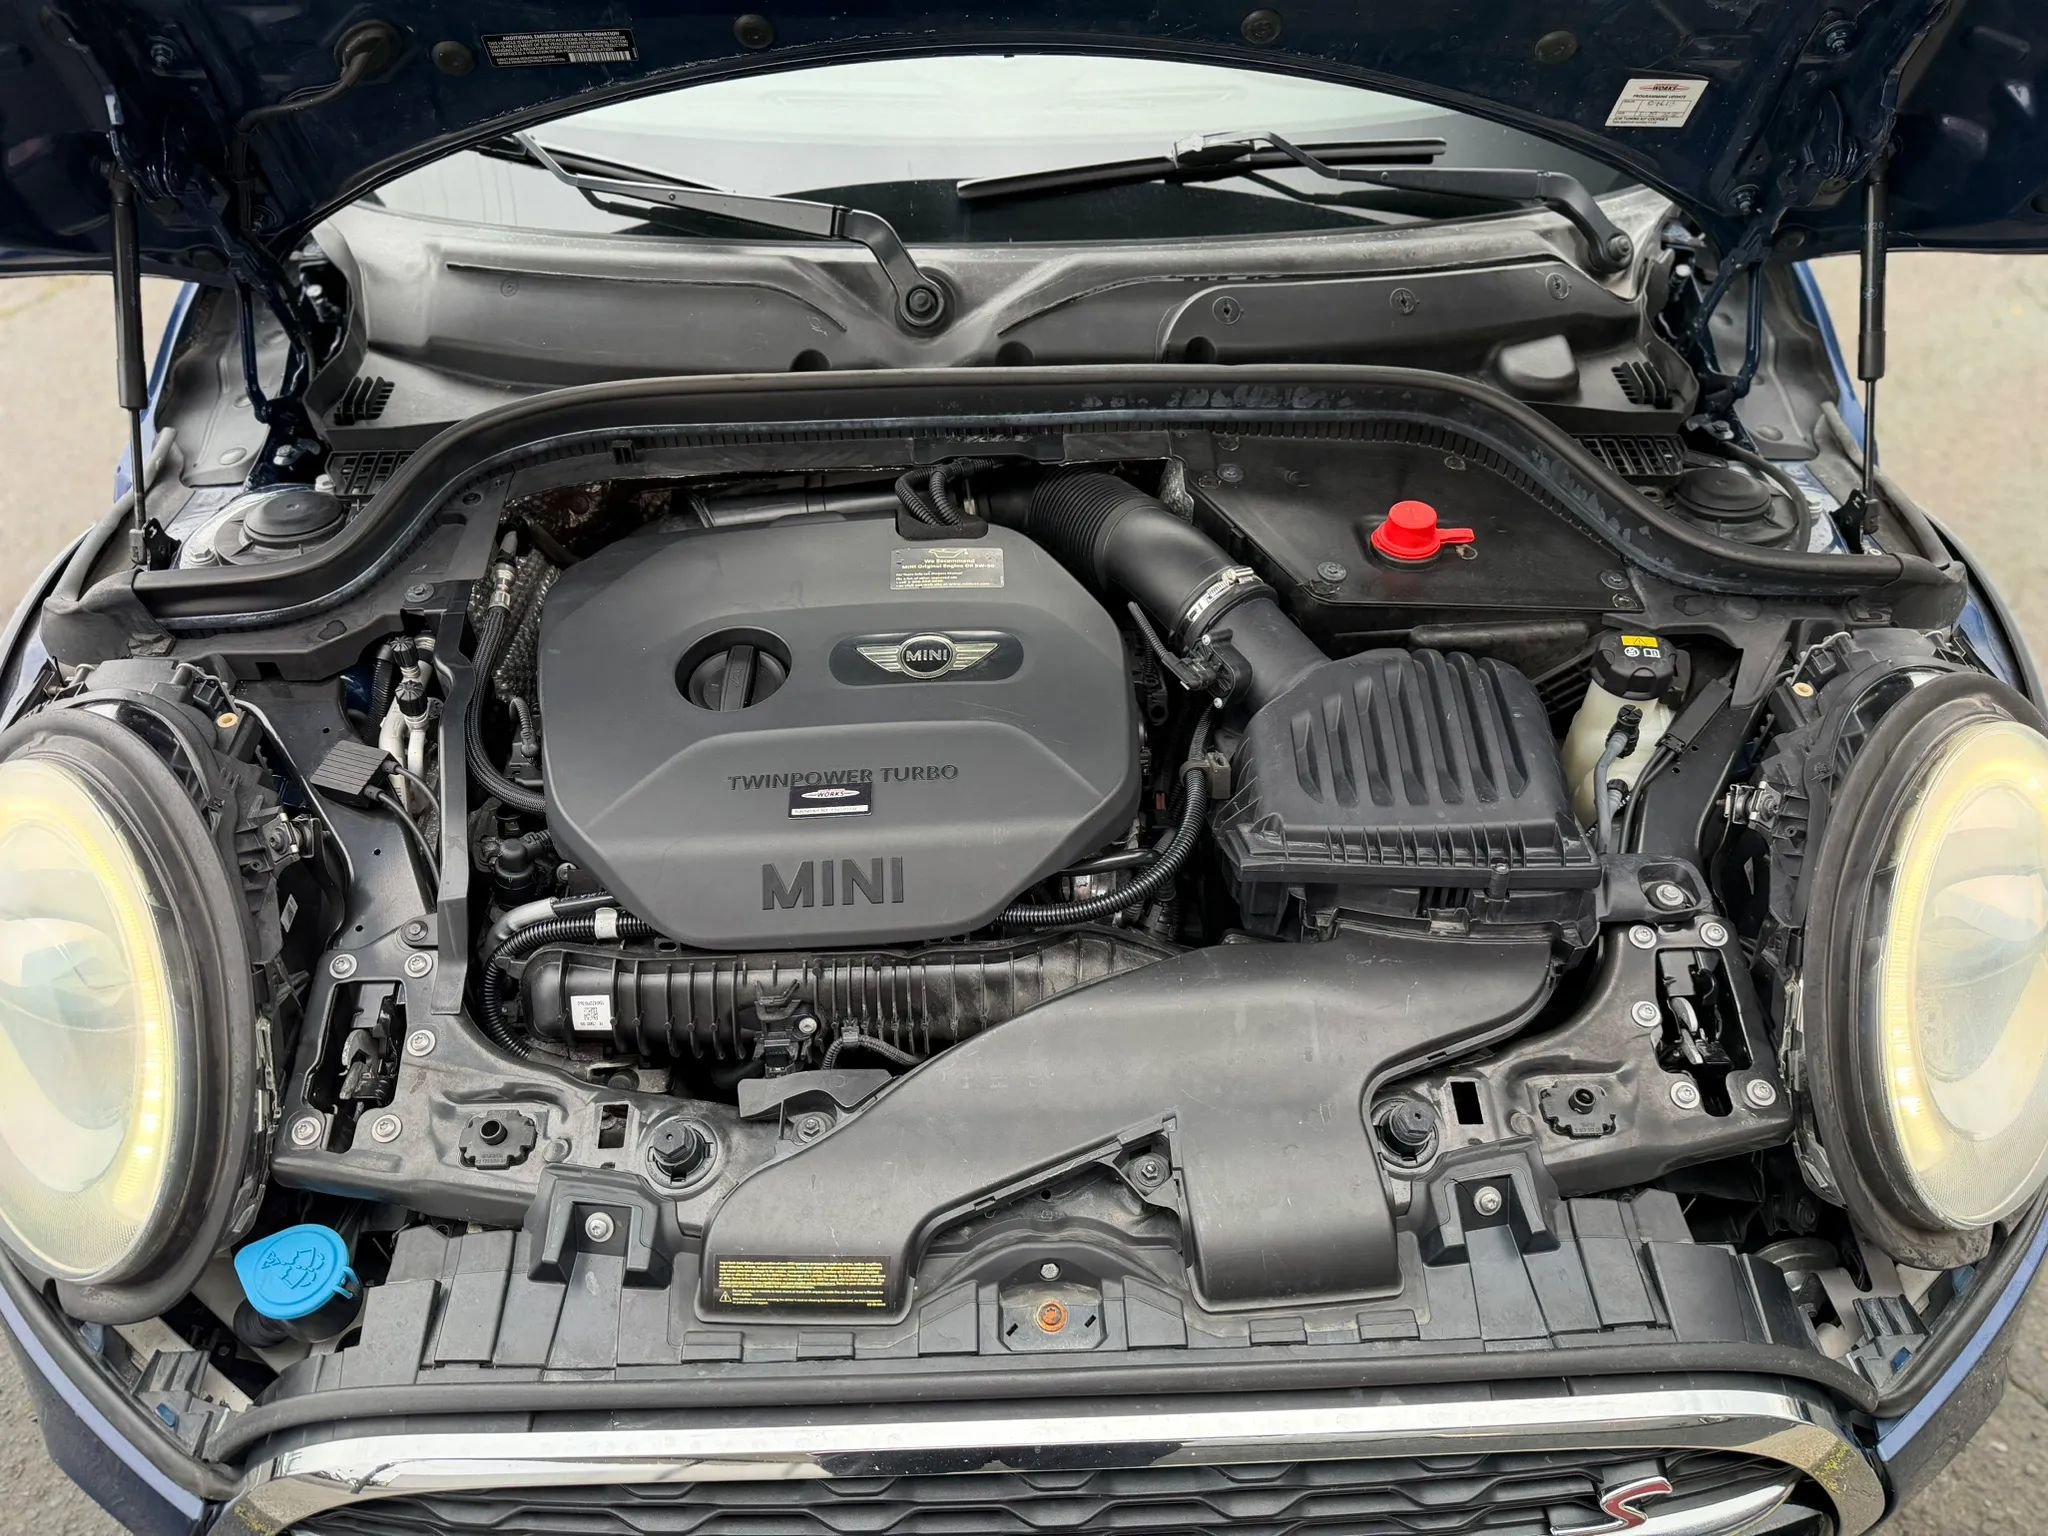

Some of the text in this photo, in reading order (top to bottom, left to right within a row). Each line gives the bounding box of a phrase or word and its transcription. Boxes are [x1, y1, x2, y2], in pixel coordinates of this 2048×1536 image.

[905, 649, 948, 662] MINI
[727, 764, 959, 791] TWINPOWER TURBO
[817, 790, 845, 798] WORKS
[762, 856, 904, 910] MINI
